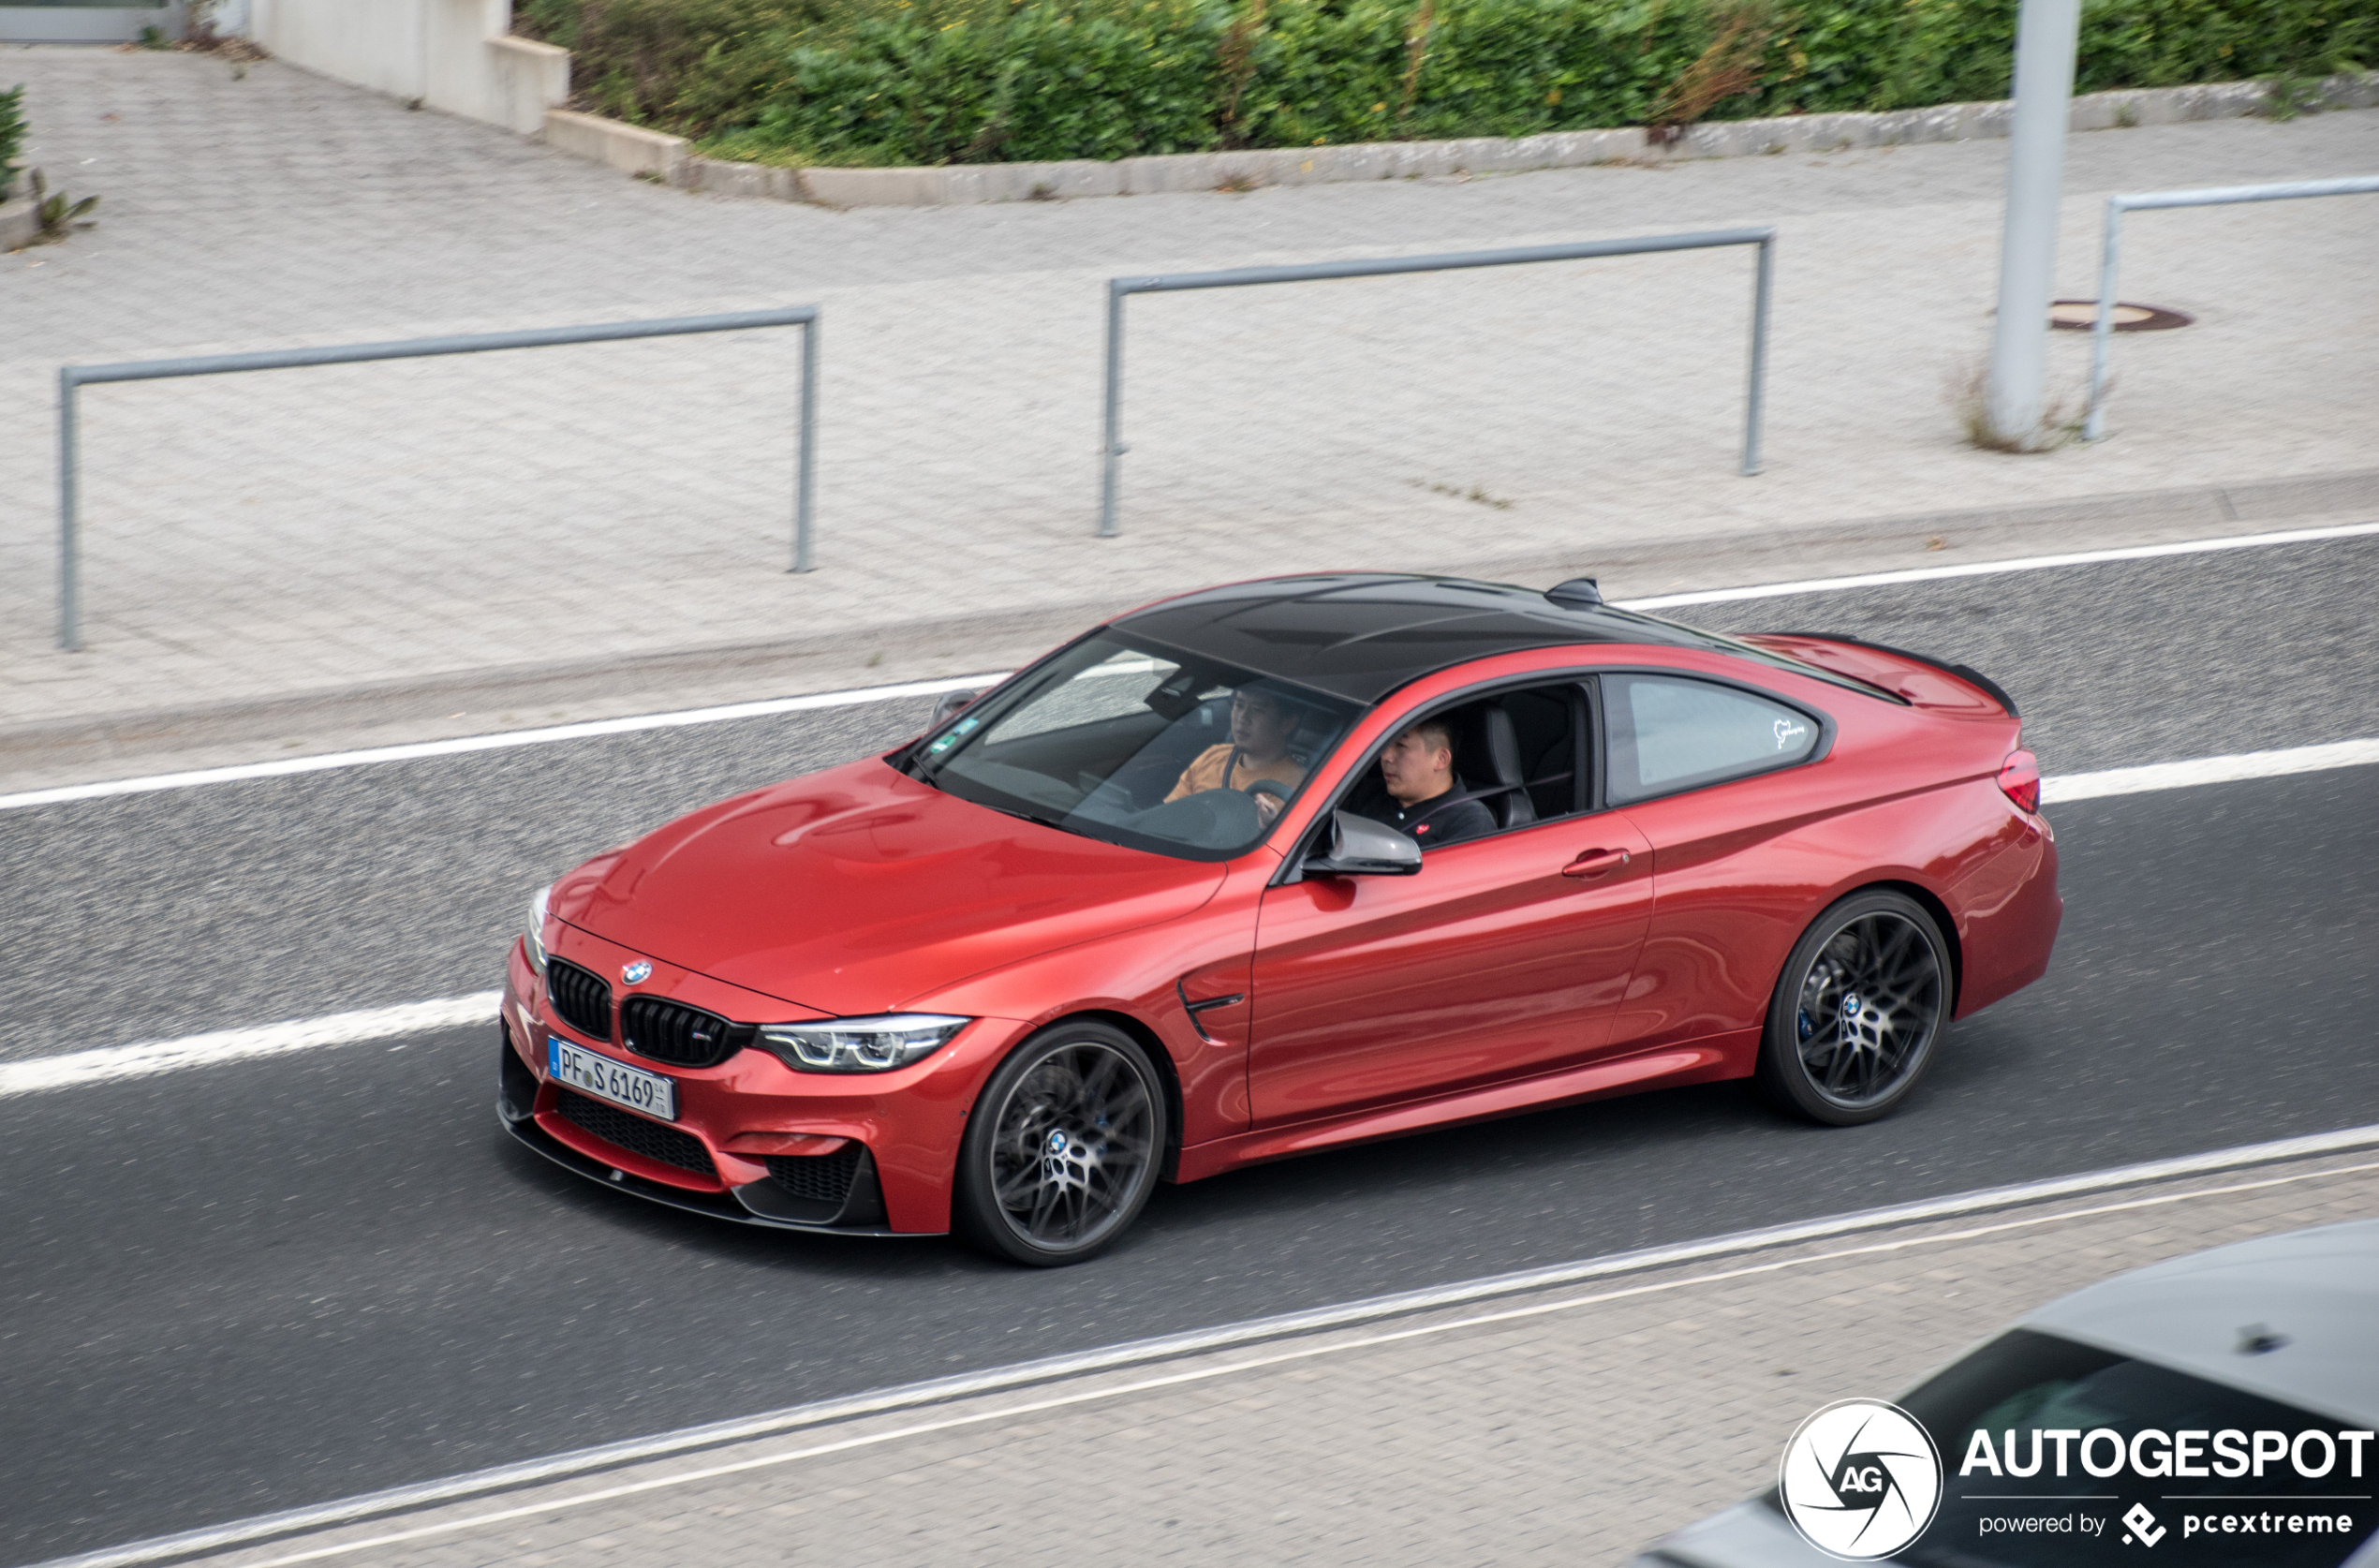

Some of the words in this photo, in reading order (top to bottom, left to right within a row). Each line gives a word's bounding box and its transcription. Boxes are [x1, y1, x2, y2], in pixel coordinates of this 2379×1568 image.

[562, 1048, 583, 1081] PF
[595, 1061, 606, 1091] S
[610, 1069, 654, 1107] 6169
